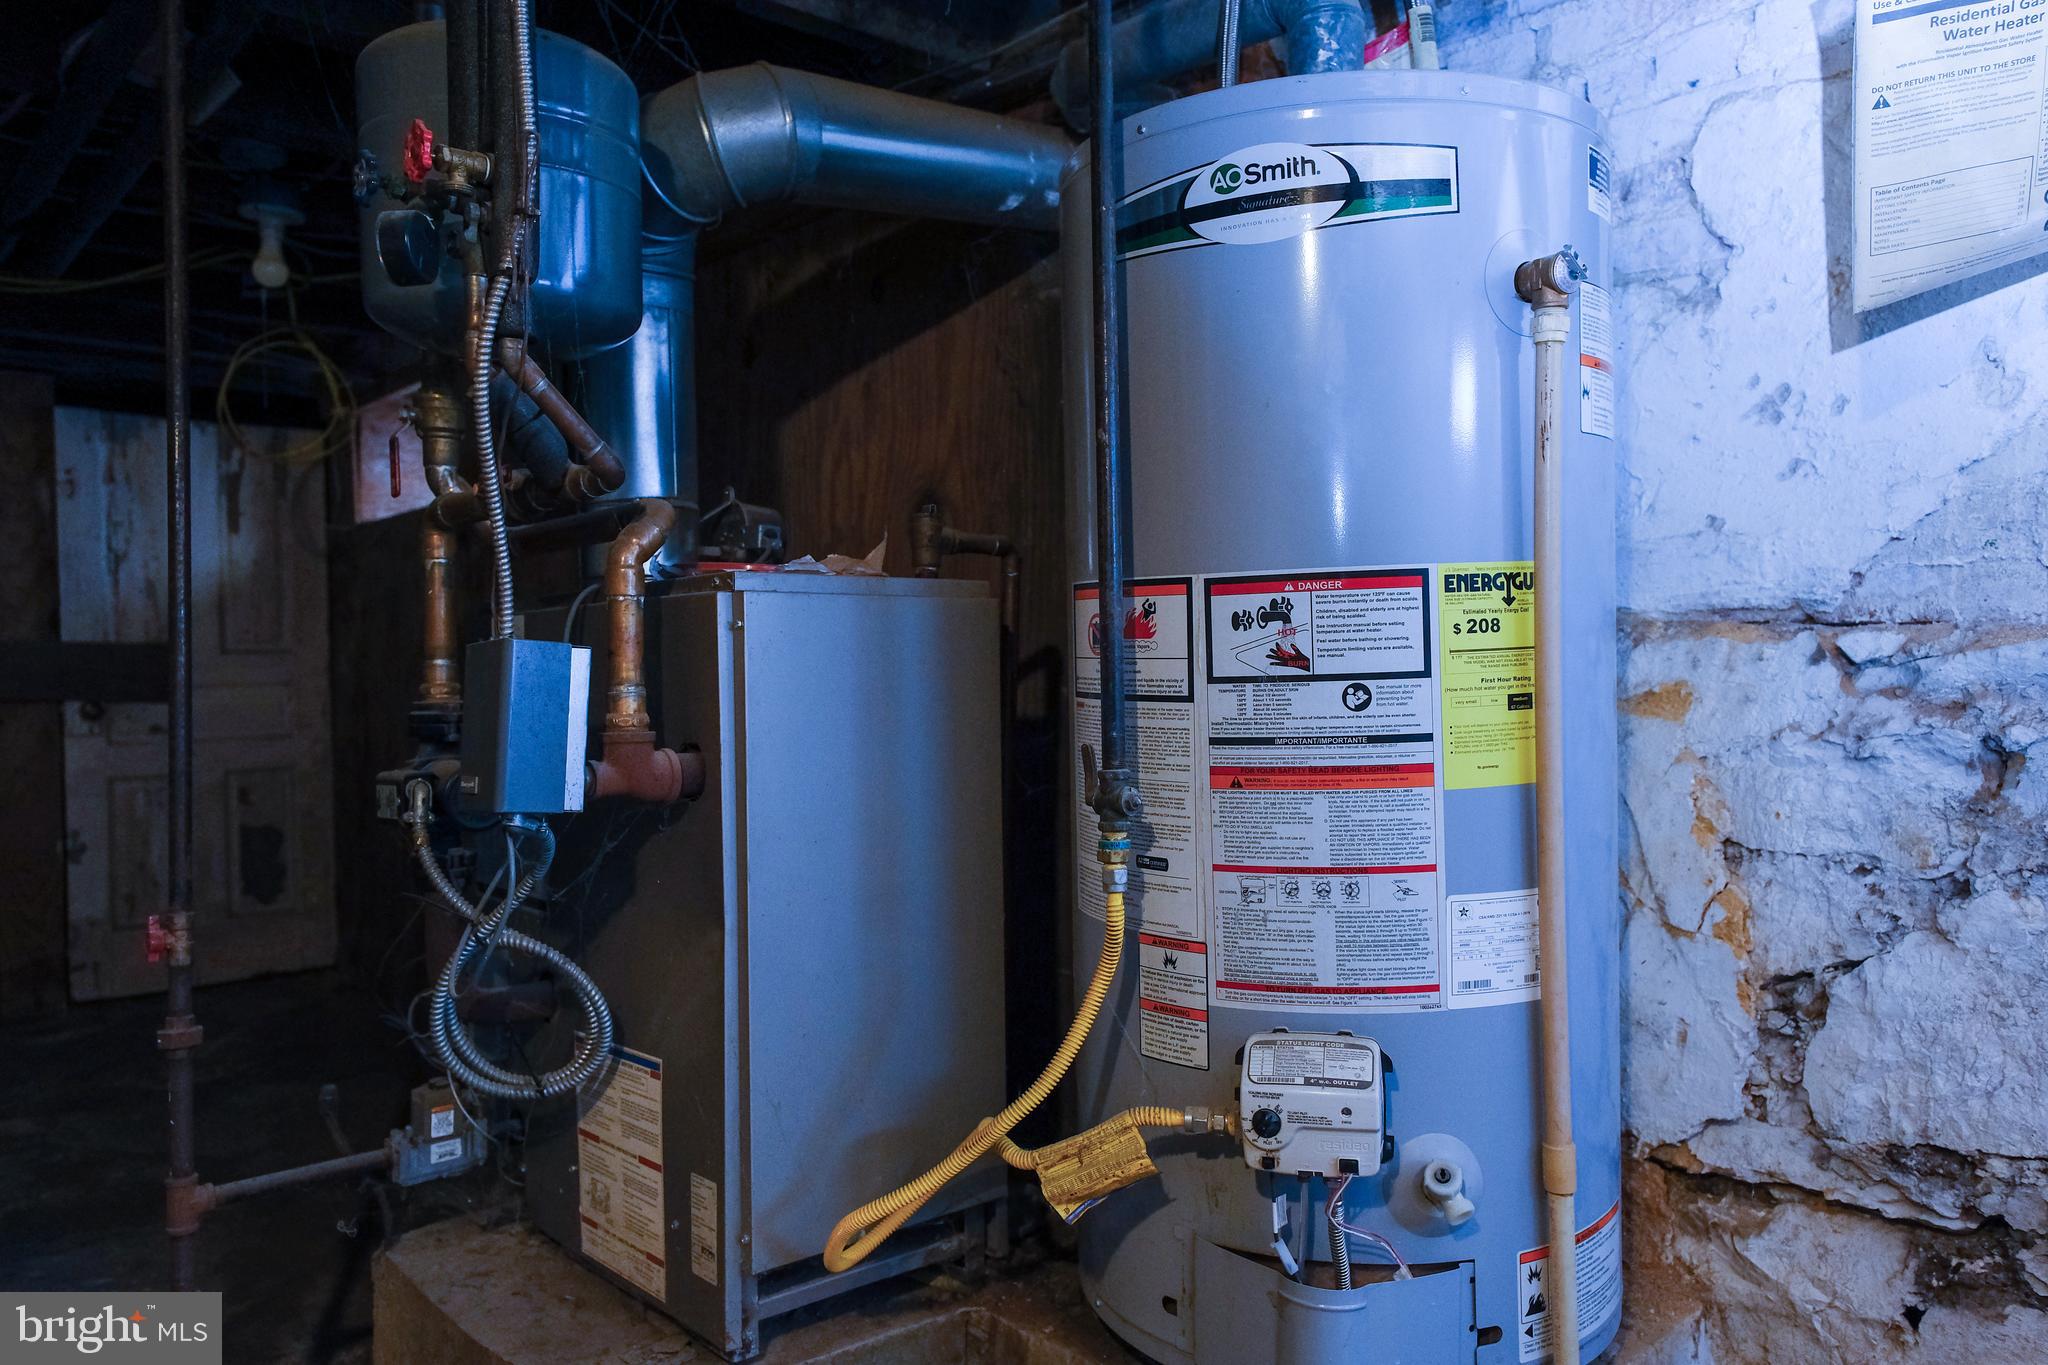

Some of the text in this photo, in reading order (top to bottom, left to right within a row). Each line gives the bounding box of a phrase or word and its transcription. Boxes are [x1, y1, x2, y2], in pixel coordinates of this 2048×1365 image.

[1873, 0, 1891, 10] Use
[1930, 0, 2015, 28] Residential
[1943, 11, 2045, 41] Water Heater
[1871, 54, 2037, 94] DO NOT RETURN THIS UNIT TO THE STORE
[1875, 188, 1892, 196] Table
[1901, 181, 1929, 192] Contents
[1931, 177, 1946, 187] Page
[1220, 220, 1262, 232] INNOVATION
[1298, 581, 1342, 590] DANGER
[1444, 572, 1534, 599] ENERGYGU
[1453, 618, 1500, 635] $ 208
[1274, 737, 1367, 745] IMPORTANT/IMPORTANTE
[1364, 765, 1400, 773] LIGHTING
[1158, 940, 1189, 950] WARNING
[1158, 1005, 1190, 1017] WARNING
